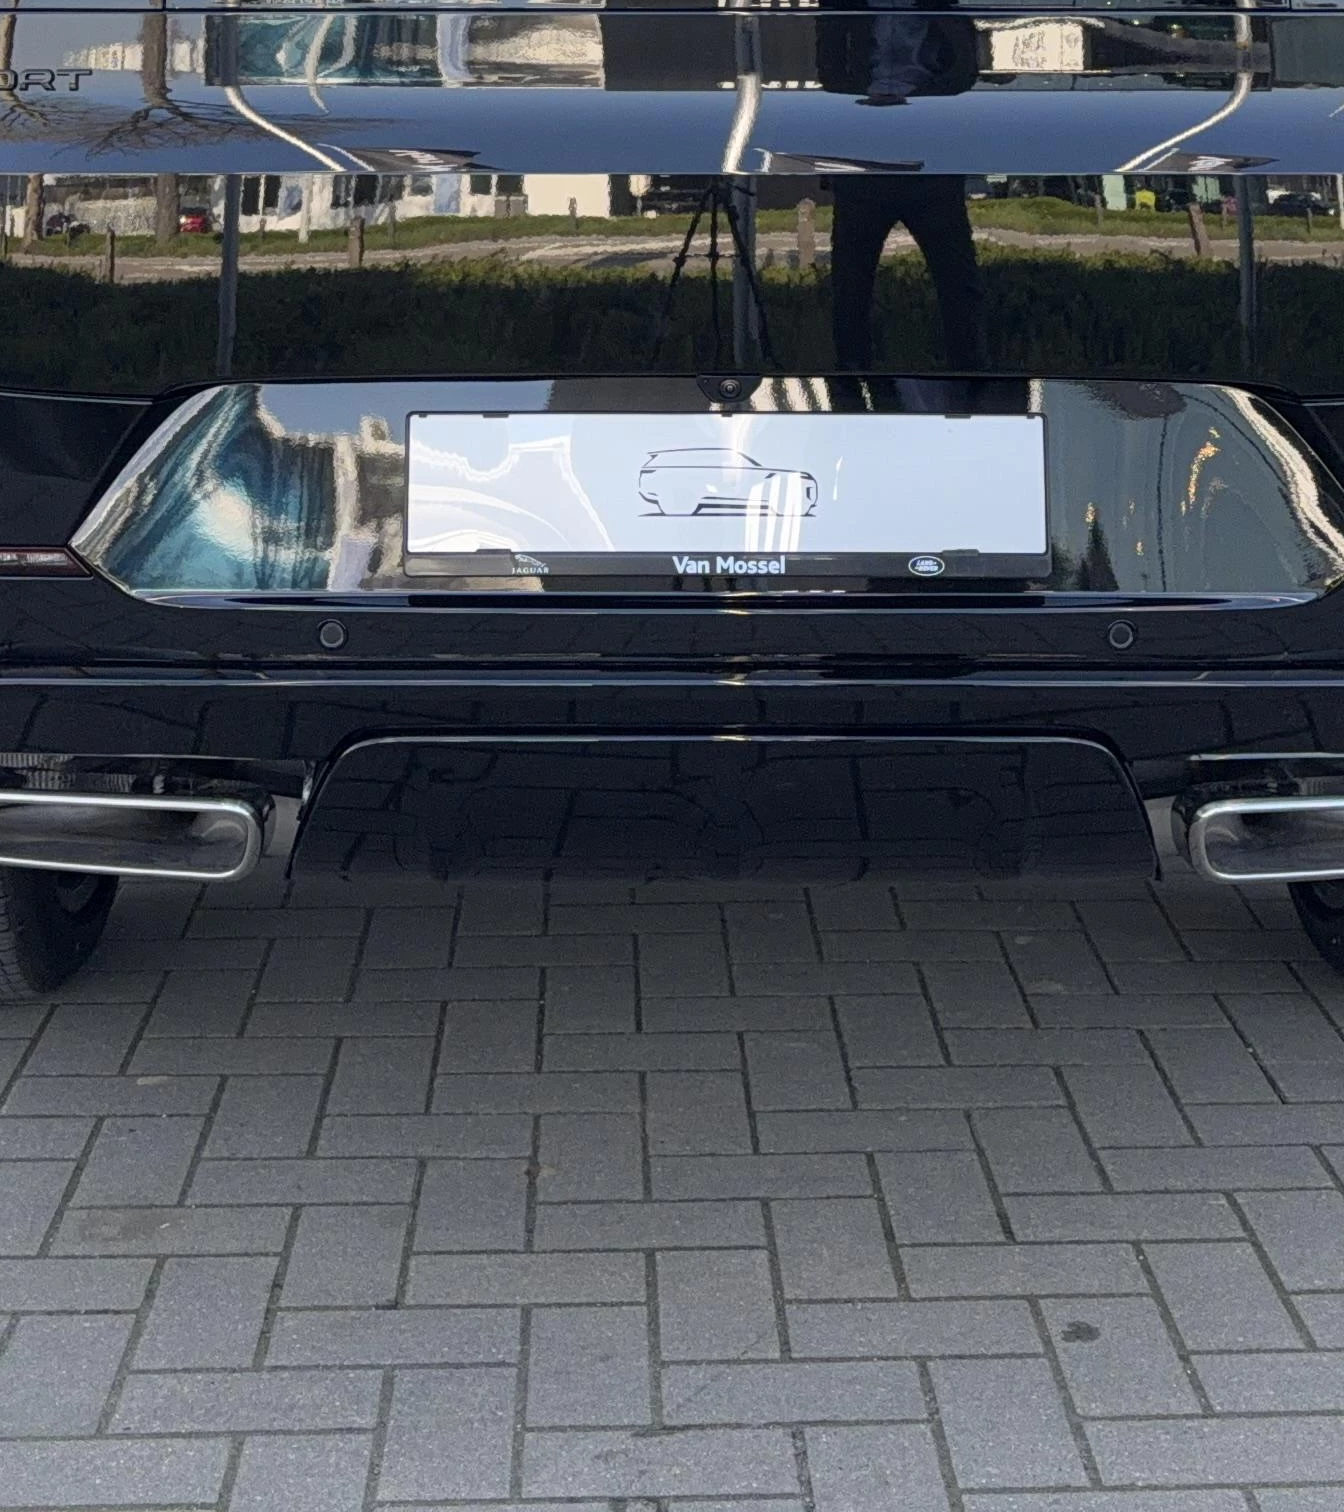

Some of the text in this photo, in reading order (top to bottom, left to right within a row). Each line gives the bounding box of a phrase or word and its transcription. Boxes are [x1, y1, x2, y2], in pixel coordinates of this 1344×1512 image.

[511, 567, 550, 575] JAGUAR
[672, 554, 786, 575] Van Mossel
